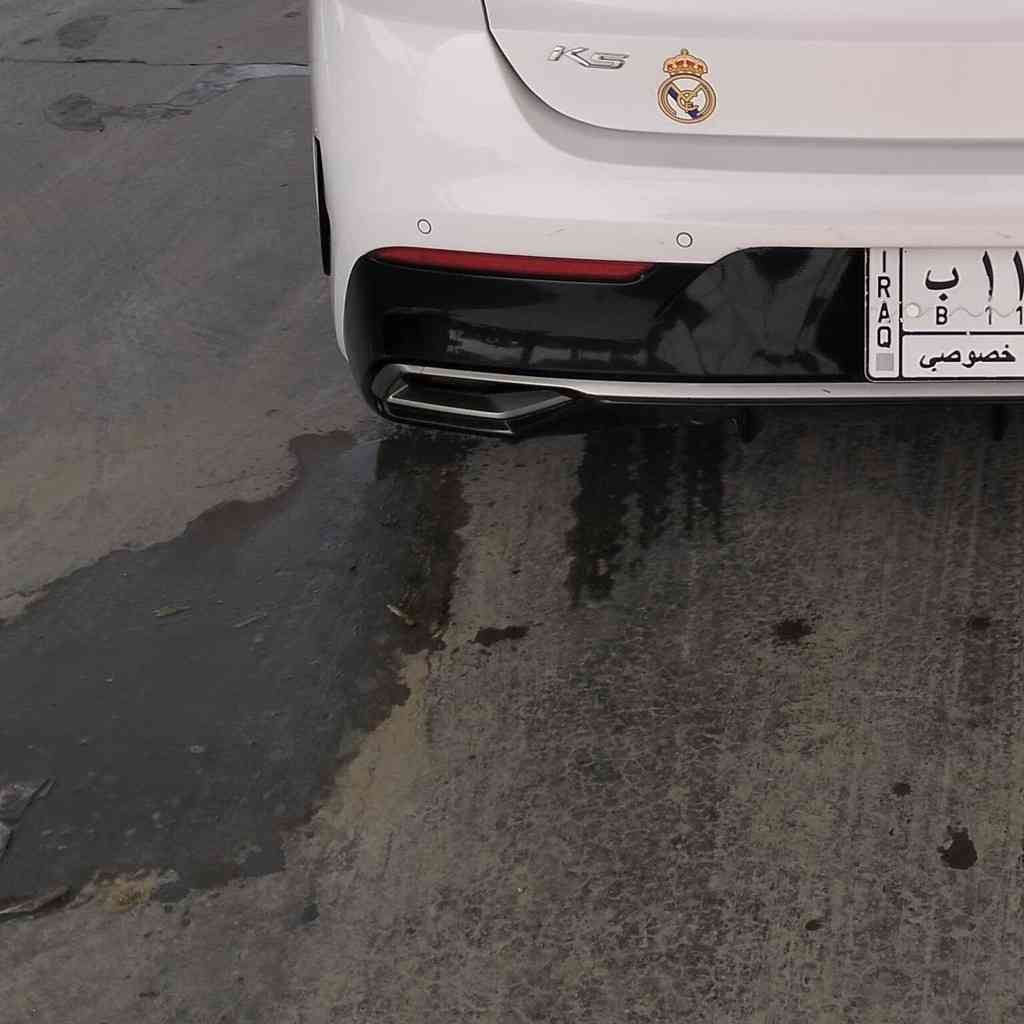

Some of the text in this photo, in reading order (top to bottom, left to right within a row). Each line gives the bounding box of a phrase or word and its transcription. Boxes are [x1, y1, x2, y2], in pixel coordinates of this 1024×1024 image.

[548, 45, 630, 69] K5
[876, 250, 892, 348] IRAQ
[919, 344, 1016, 372] خصوصي
